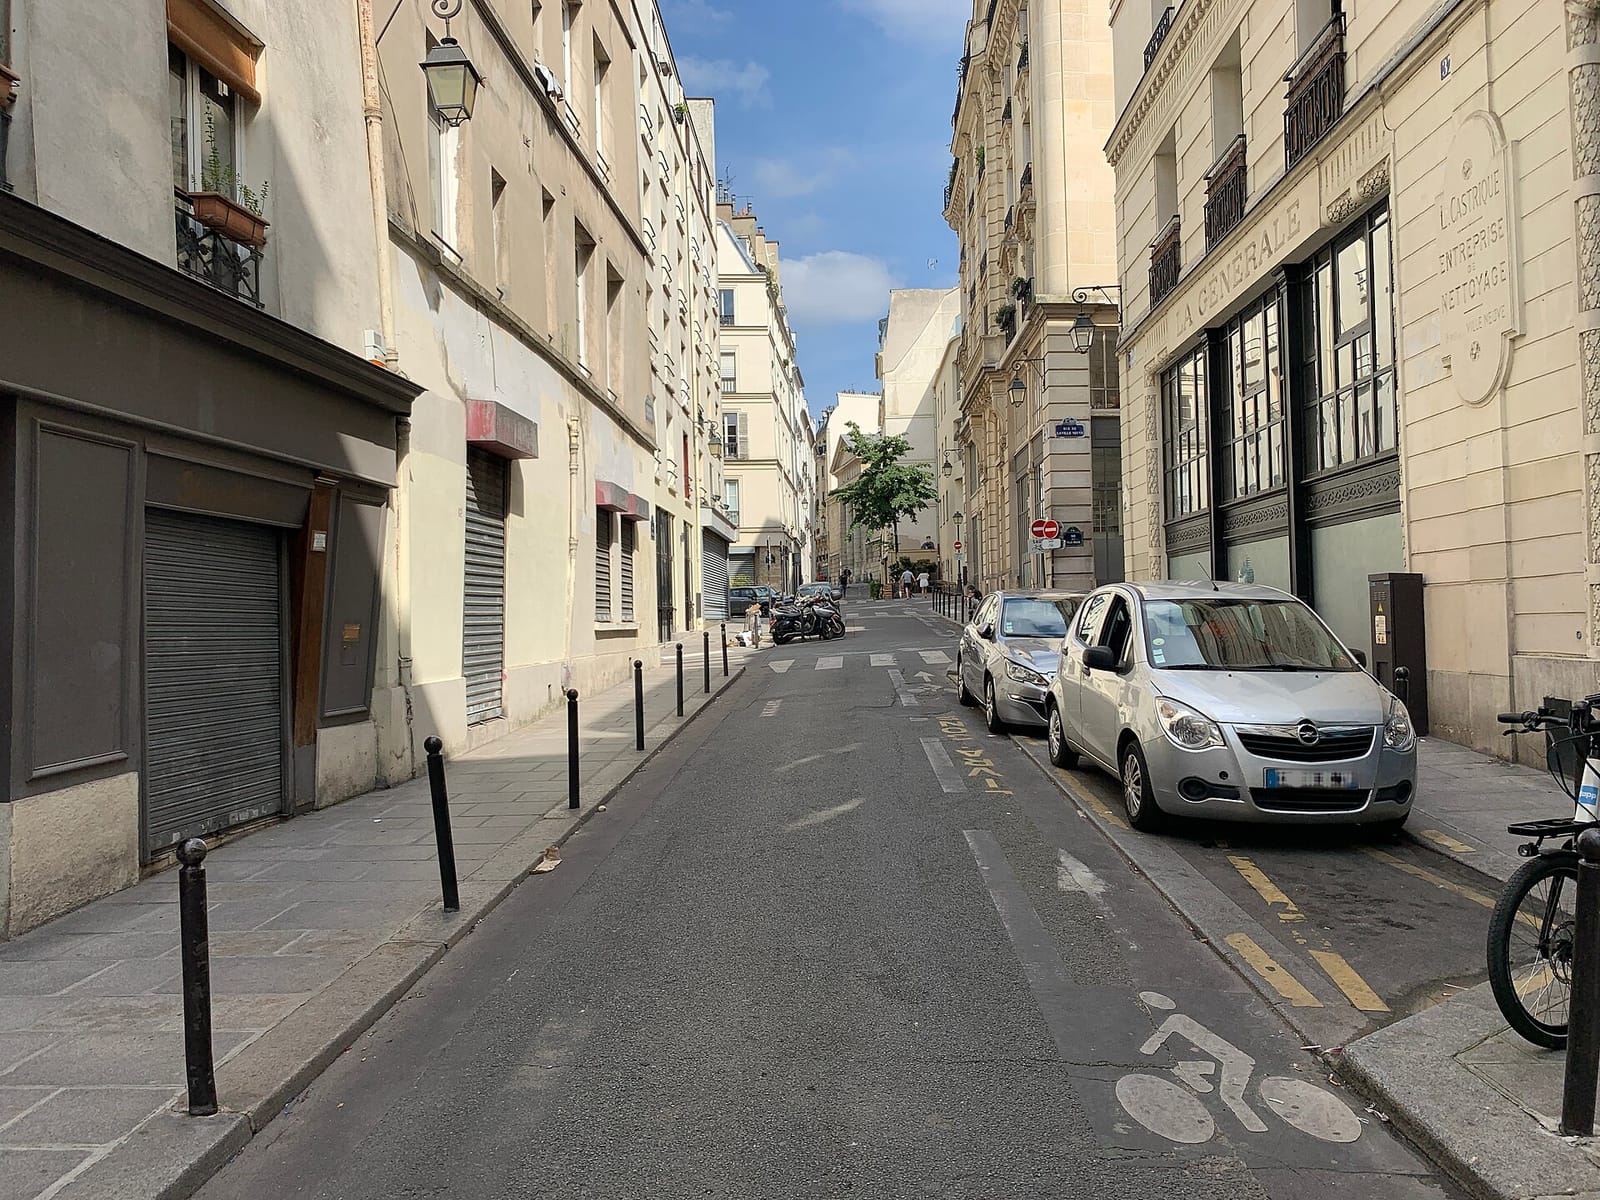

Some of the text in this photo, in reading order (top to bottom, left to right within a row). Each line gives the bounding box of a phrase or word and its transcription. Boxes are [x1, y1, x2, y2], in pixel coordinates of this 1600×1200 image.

[1439, 217, 1504, 275] ENTREPRISE
[1441, 260, 1507, 315] NETTOYAGE
[1175, 303, 1193, 337] LA
